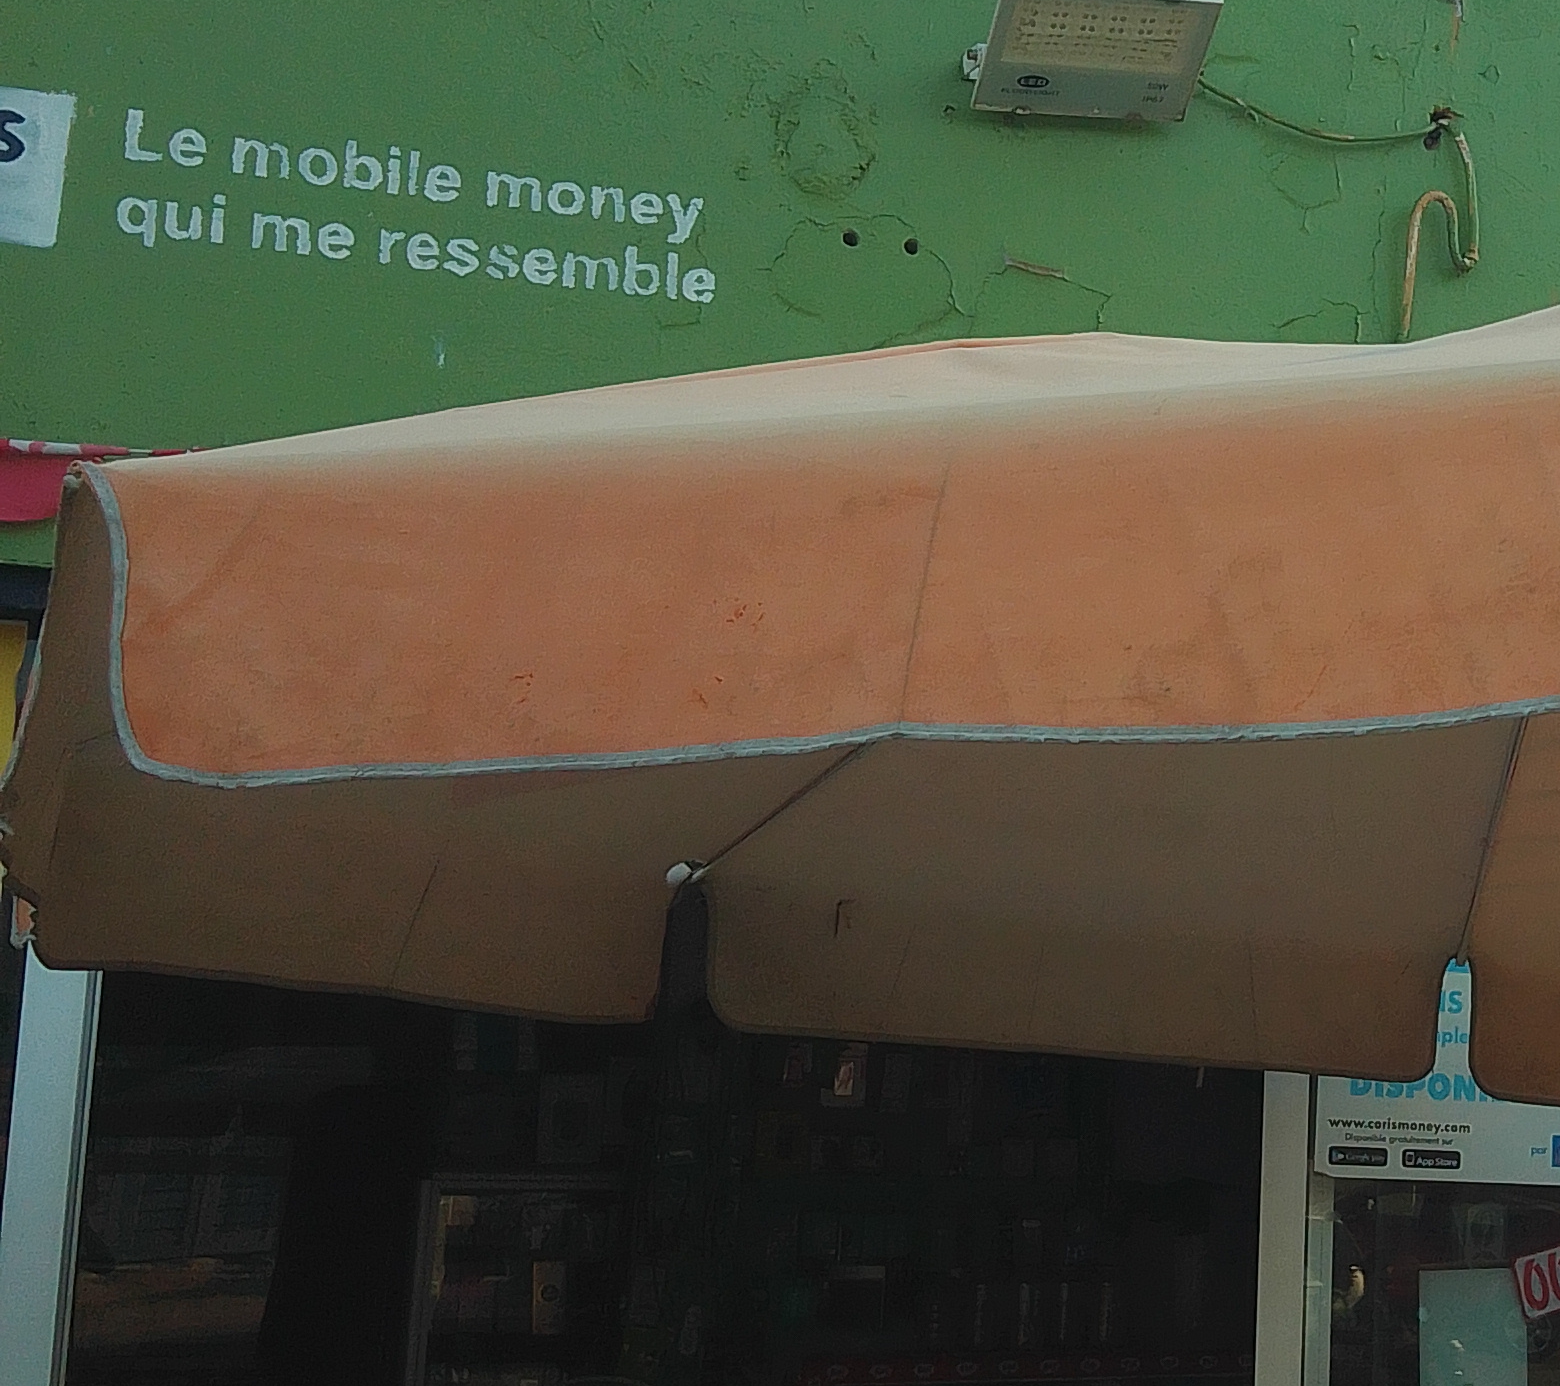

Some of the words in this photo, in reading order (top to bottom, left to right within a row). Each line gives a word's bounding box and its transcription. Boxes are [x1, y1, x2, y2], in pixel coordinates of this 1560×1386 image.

[123, 108, 208, 167] Le
[230, 134, 462, 203] mobile
[486, 169, 705, 244] money
[115, 193, 227, 248] qui
[251, 209, 356, 260] me
[378, 225, 717, 304] ressemble
[1350, 1072, 1499, 1102] DISPON
[1327, 1117, 1471, 1135] www.corismoney.com
